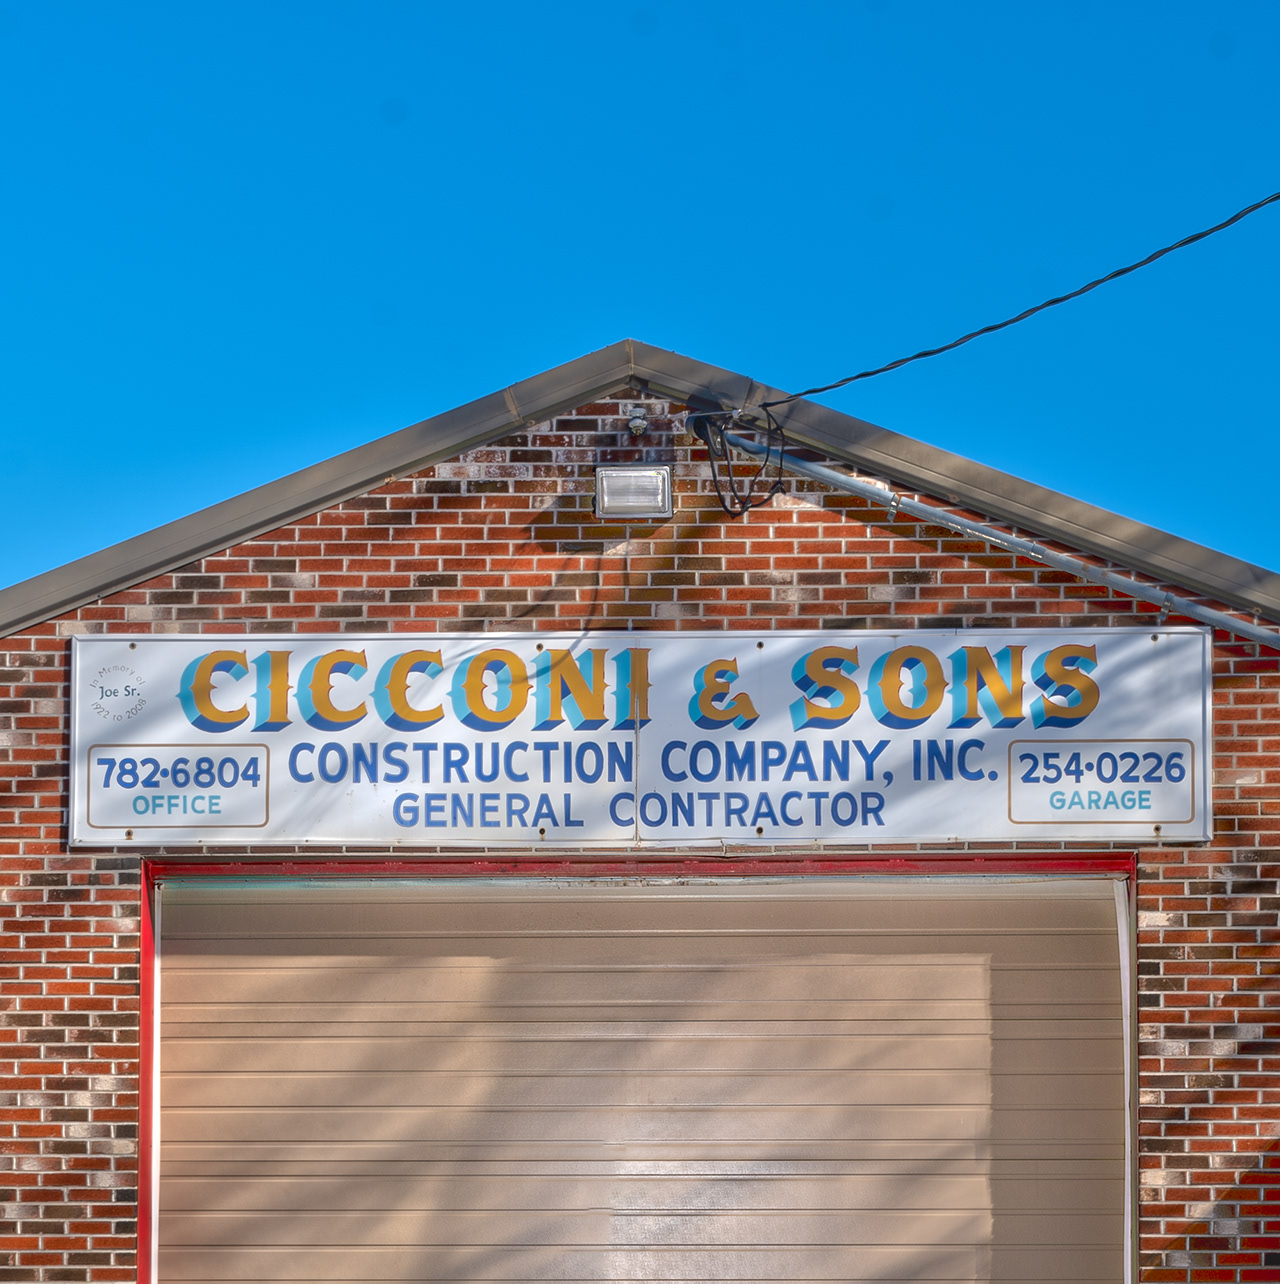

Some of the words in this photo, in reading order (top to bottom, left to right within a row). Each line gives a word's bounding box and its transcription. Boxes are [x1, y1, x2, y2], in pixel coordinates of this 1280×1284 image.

[89, 679, 99, 688] In
[98, 665, 135, 678] Memory
[136, 676, 146, 685] of
[99, 685, 119, 700] Joe
[124, 685, 140, 697] Sr.
[177, 648, 652, 733] CICCONI
[688, 656, 760, 731] &
[790, 643, 1102, 733] SONS
[91, 701, 110, 719] 1922
[125, 698, 147, 719] 2008
[288, 740, 634, 785] CONSTRUCTION
[661, 739, 895, 788] COMPANY,
[912, 739, 999, 782] INC.
[132, 794, 222, 815] OFFICE
[392, 791, 585, 829] GENERAL
[609, 790, 886, 828] CONTRACTOR
[1049, 789, 1152, 811] GARAGE
